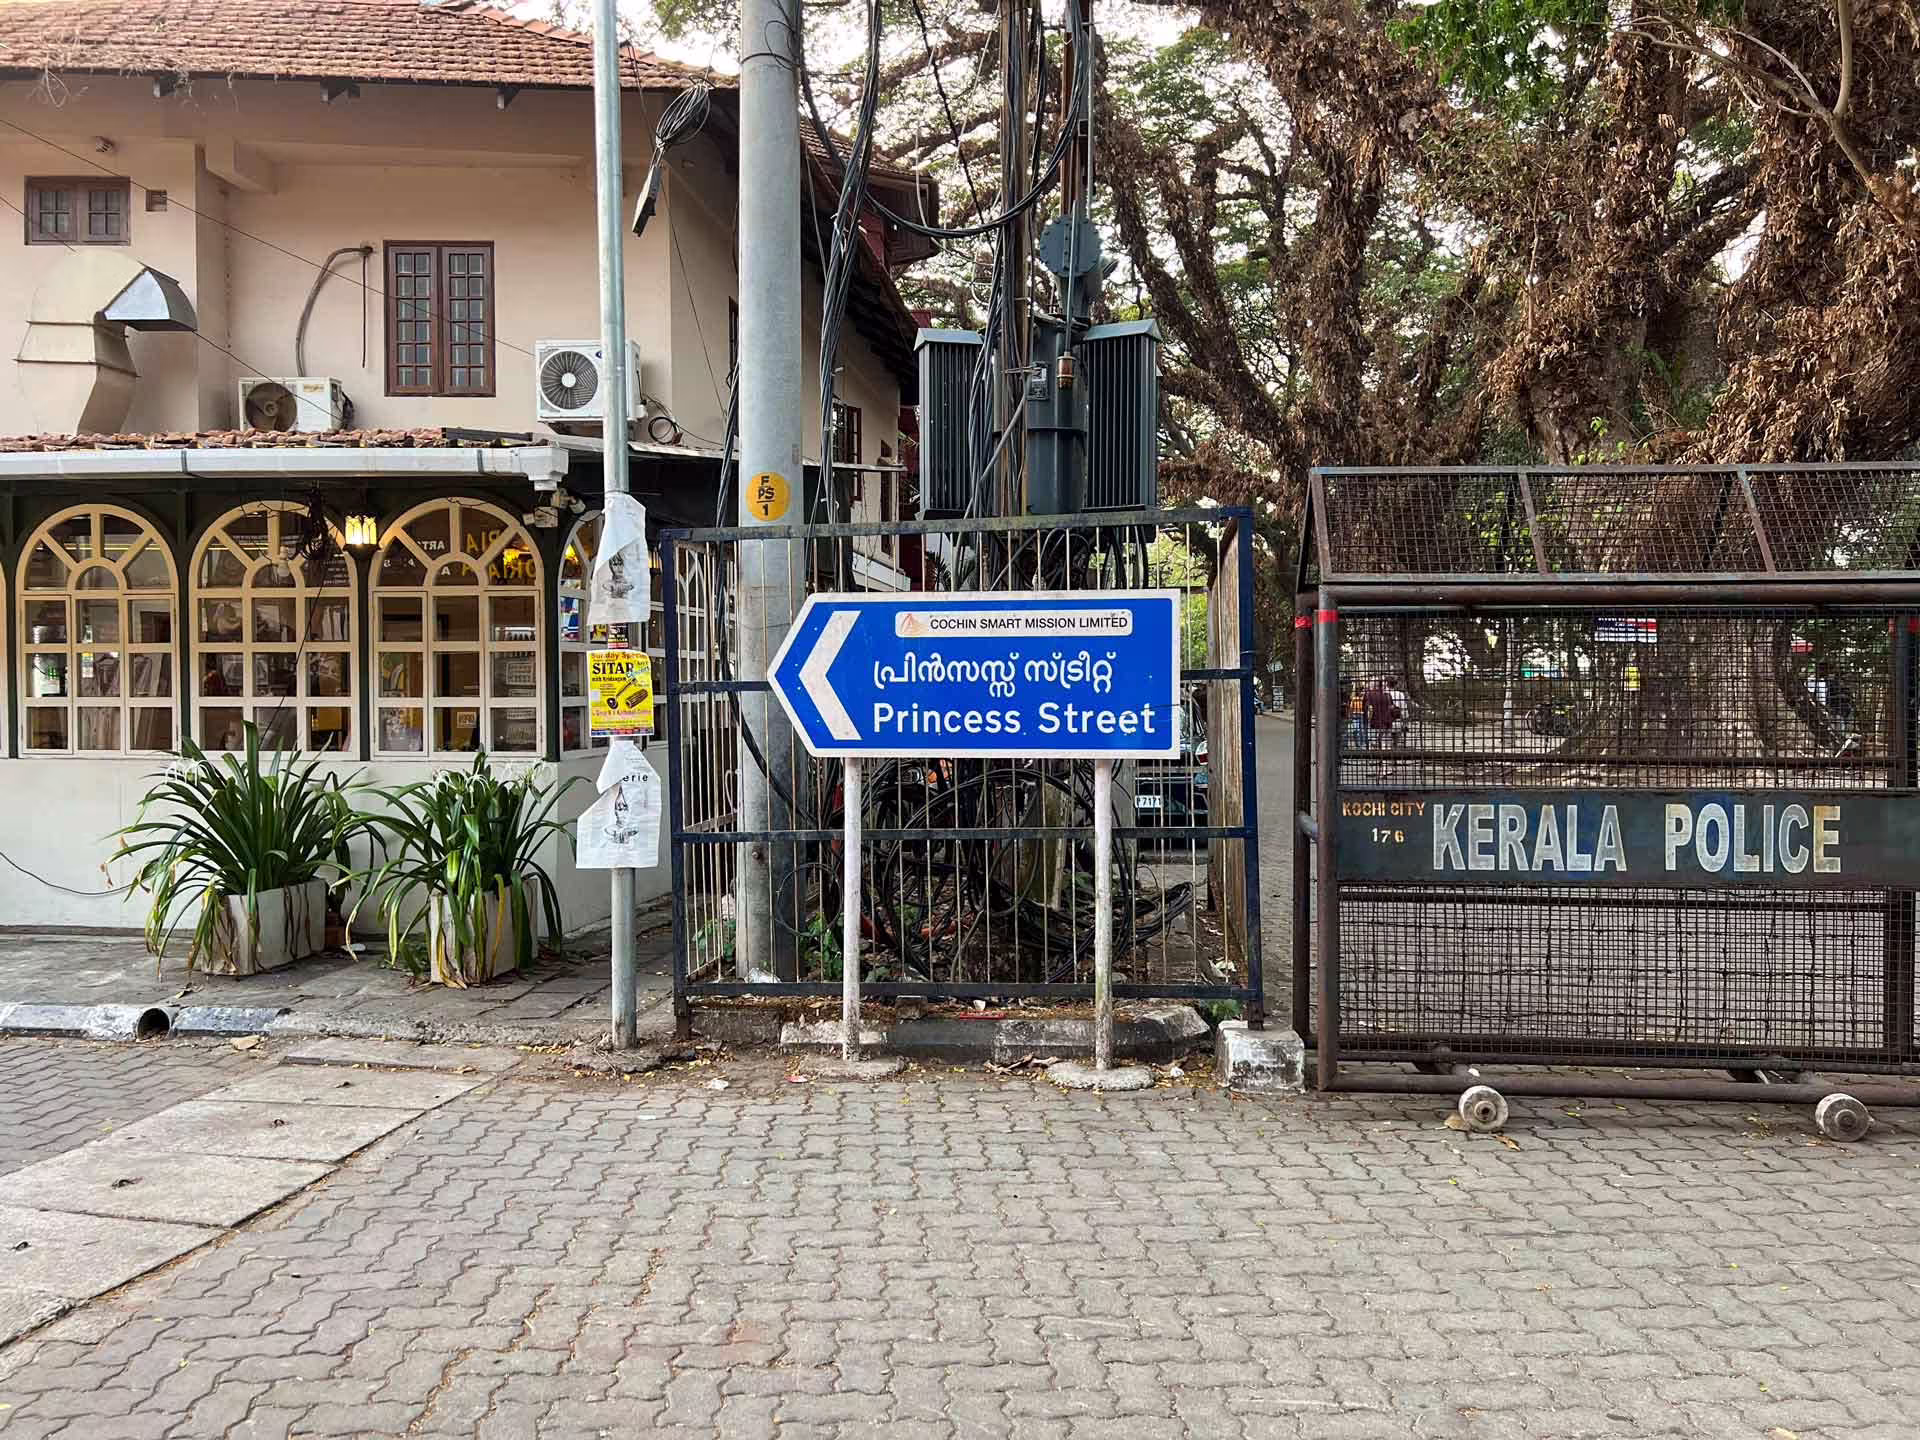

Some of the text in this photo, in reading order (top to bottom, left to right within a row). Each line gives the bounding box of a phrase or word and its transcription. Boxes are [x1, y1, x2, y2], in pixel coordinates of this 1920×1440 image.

[761, 475, 769, 485] F
[758, 487, 775, 500] PS
[762, 503, 769, 516] 1
[930, 616, 1128, 630] COCHIN SMART MISSION LIMITED
[873, 650, 1117, 698] പ്രിൻസസ്സ് സ്ട്രീറ്റ്
[873, 702, 1156, 734] Princess Street
[1343, 801, 1425, 817] KOCHI CITY
[1371, 827, 1405, 843] 176
[1432, 803, 1842, 874] KERALA POLICE
